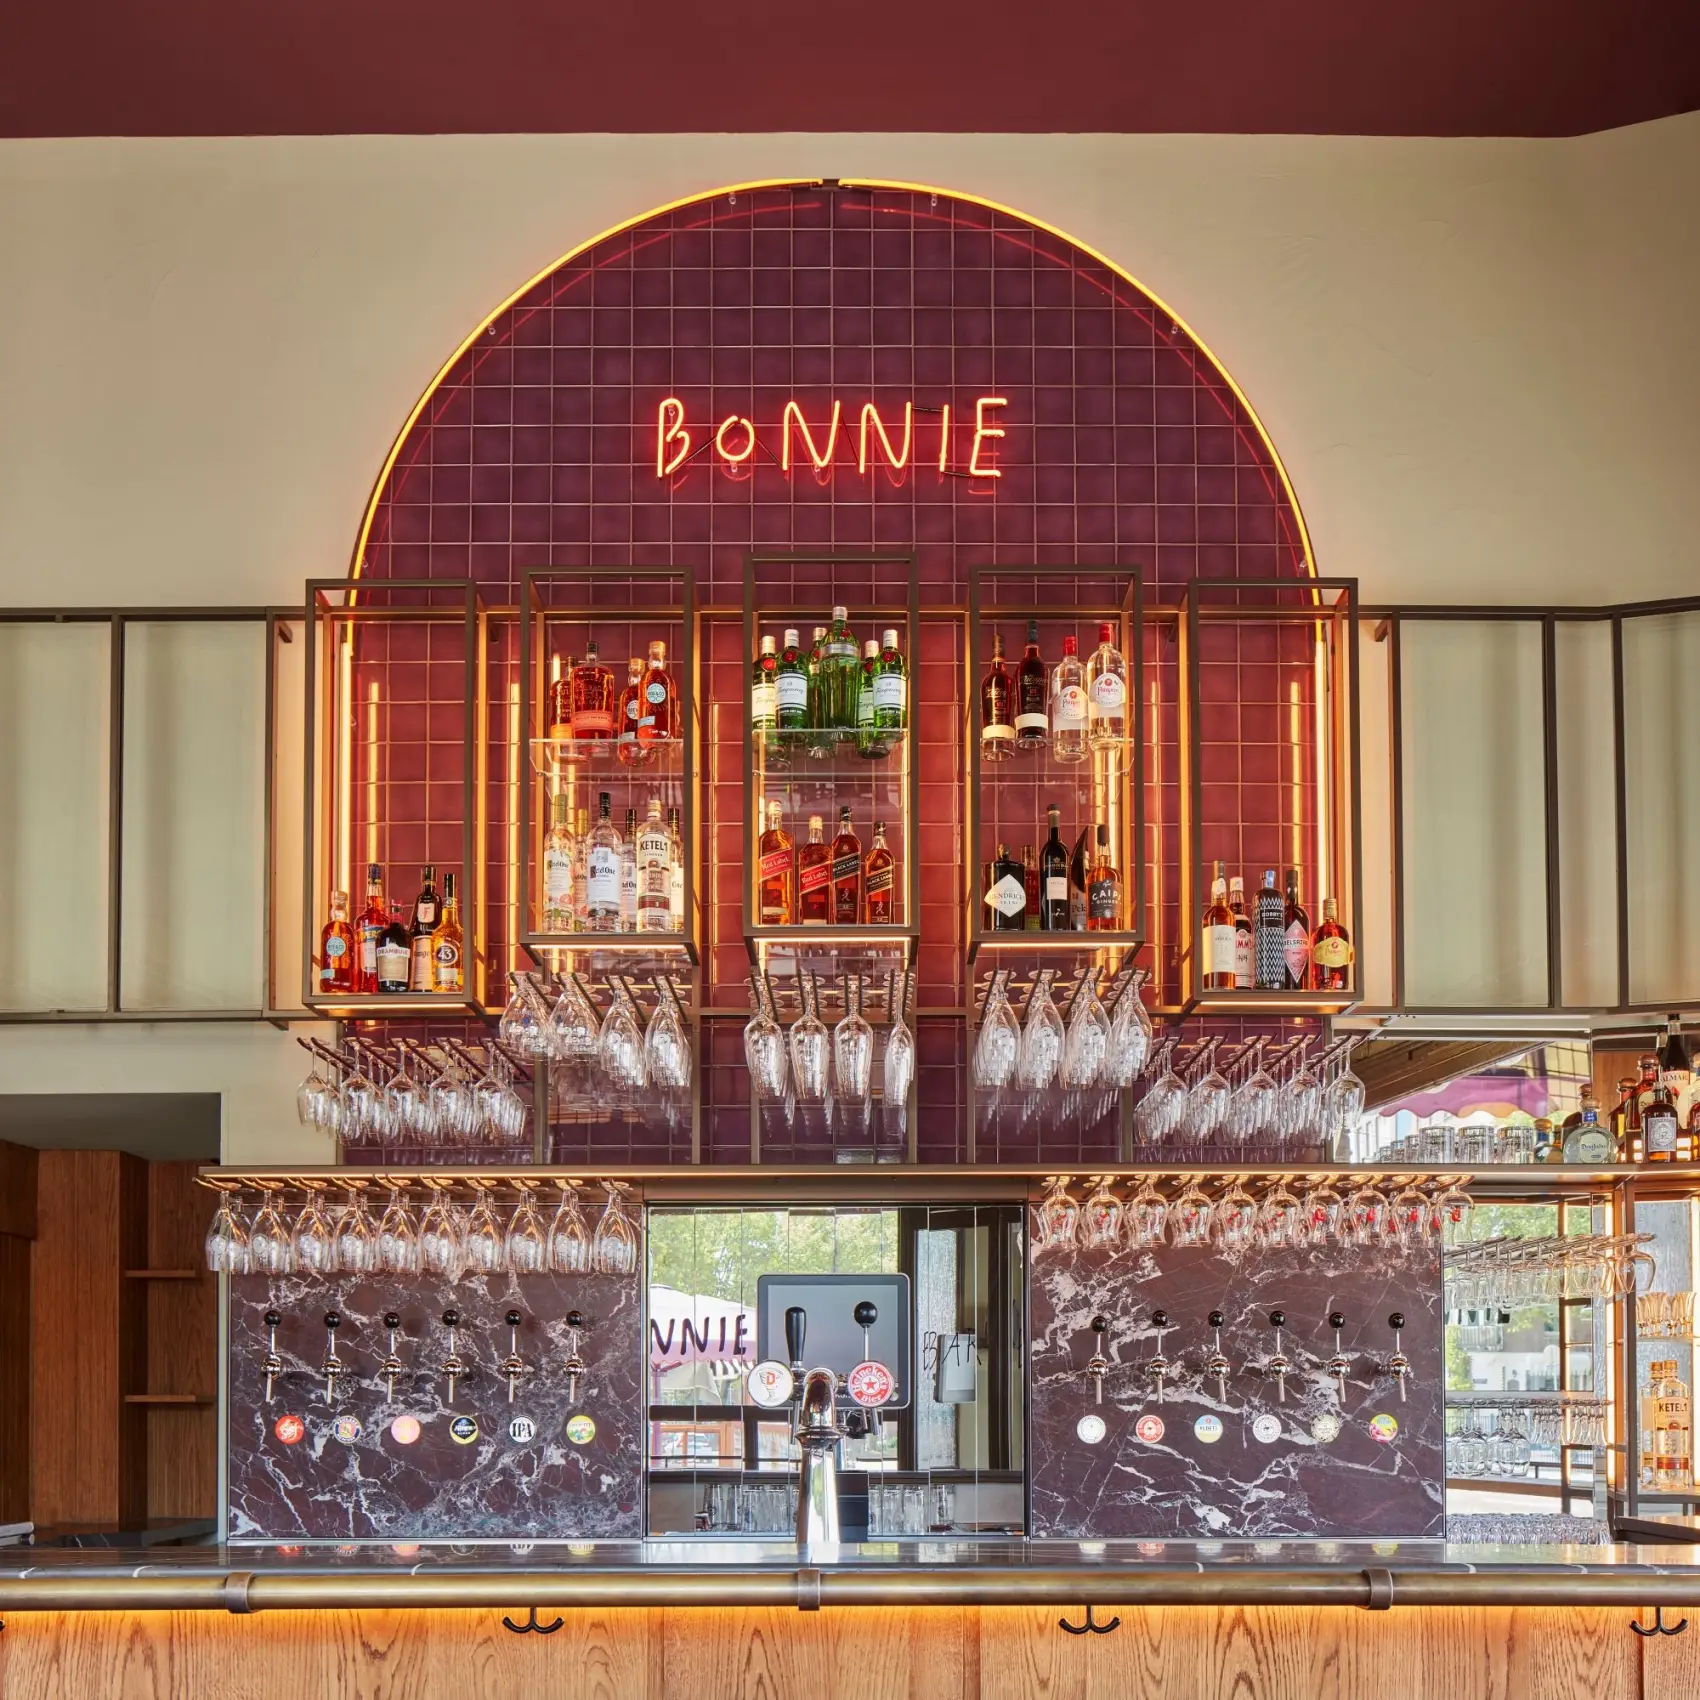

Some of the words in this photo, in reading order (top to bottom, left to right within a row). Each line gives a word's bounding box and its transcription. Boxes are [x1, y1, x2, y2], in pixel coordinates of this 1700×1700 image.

[657, 397, 1008, 479] BONNIE
[377, 947, 409, 955] DRAMBUIE
[438, 948, 453, 960] 43
[851, 1365, 889, 1391] Heineken
[512, 1422, 533, 1437] IPA
